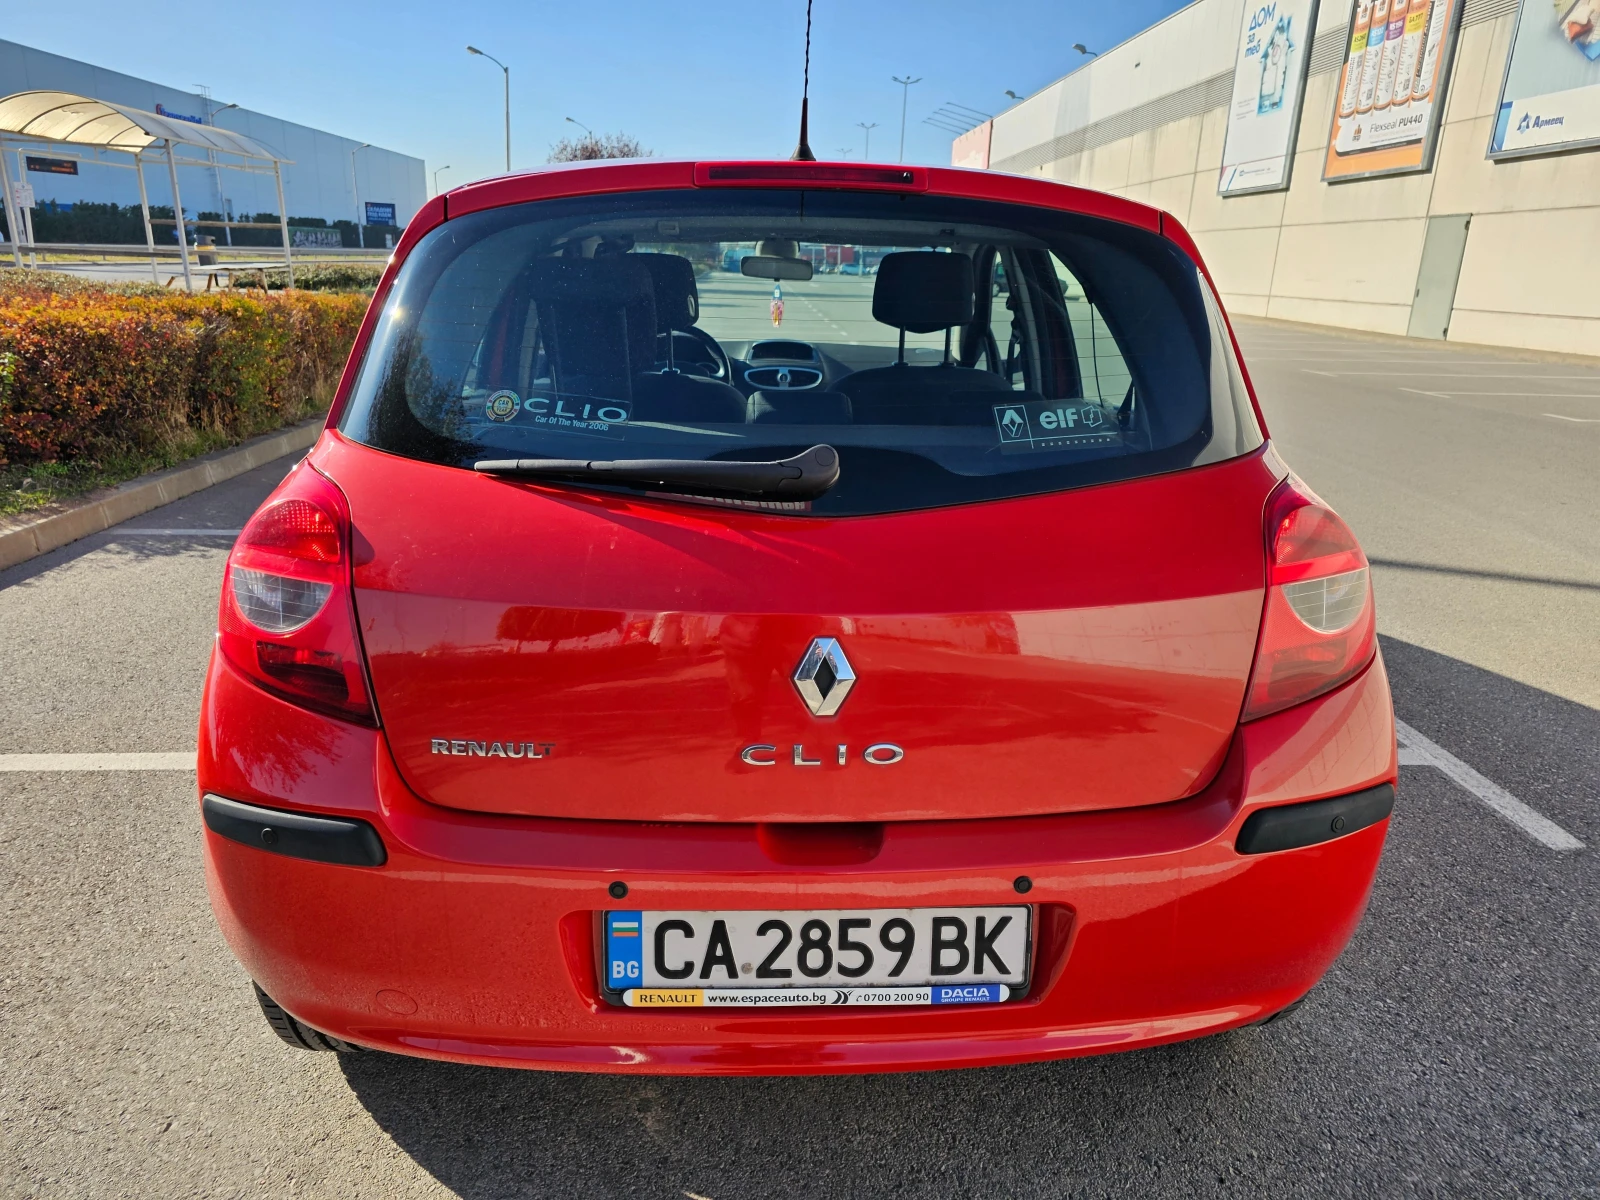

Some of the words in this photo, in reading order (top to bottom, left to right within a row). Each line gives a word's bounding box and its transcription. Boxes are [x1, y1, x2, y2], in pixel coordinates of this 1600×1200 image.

[1249, 1, 1277, 31] ДОМ
[1370, 119, 1397, 133] Flexseal
[1398, 113, 1424, 127] PU440
[1532, 115, 1564, 129] Армеец
[523, 398, 627, 422] CLIO
[1039, 408, 1078, 429] elf
[535, 415, 547, 423] Car
[549, 416, 557, 424] Of
[558, 417, 571, 426] The
[573, 419, 587, 428] Year
[589, 421, 609, 431] 2006
[431, 738, 556, 758] RENAULT
[741, 743, 905, 766] CLIO
[654, 919, 739, 979] CA
[755, 917, 915, 979] 2859
[930, 916, 1013, 976] BK
[612, 960, 639, 979] BG
[640, 994, 697, 1003] RENAULT
[708, 991, 826, 1005] www.espaceauto.bg
[864, 992, 891, 1002] 0700
[941, 988, 990, 998] DACIA
